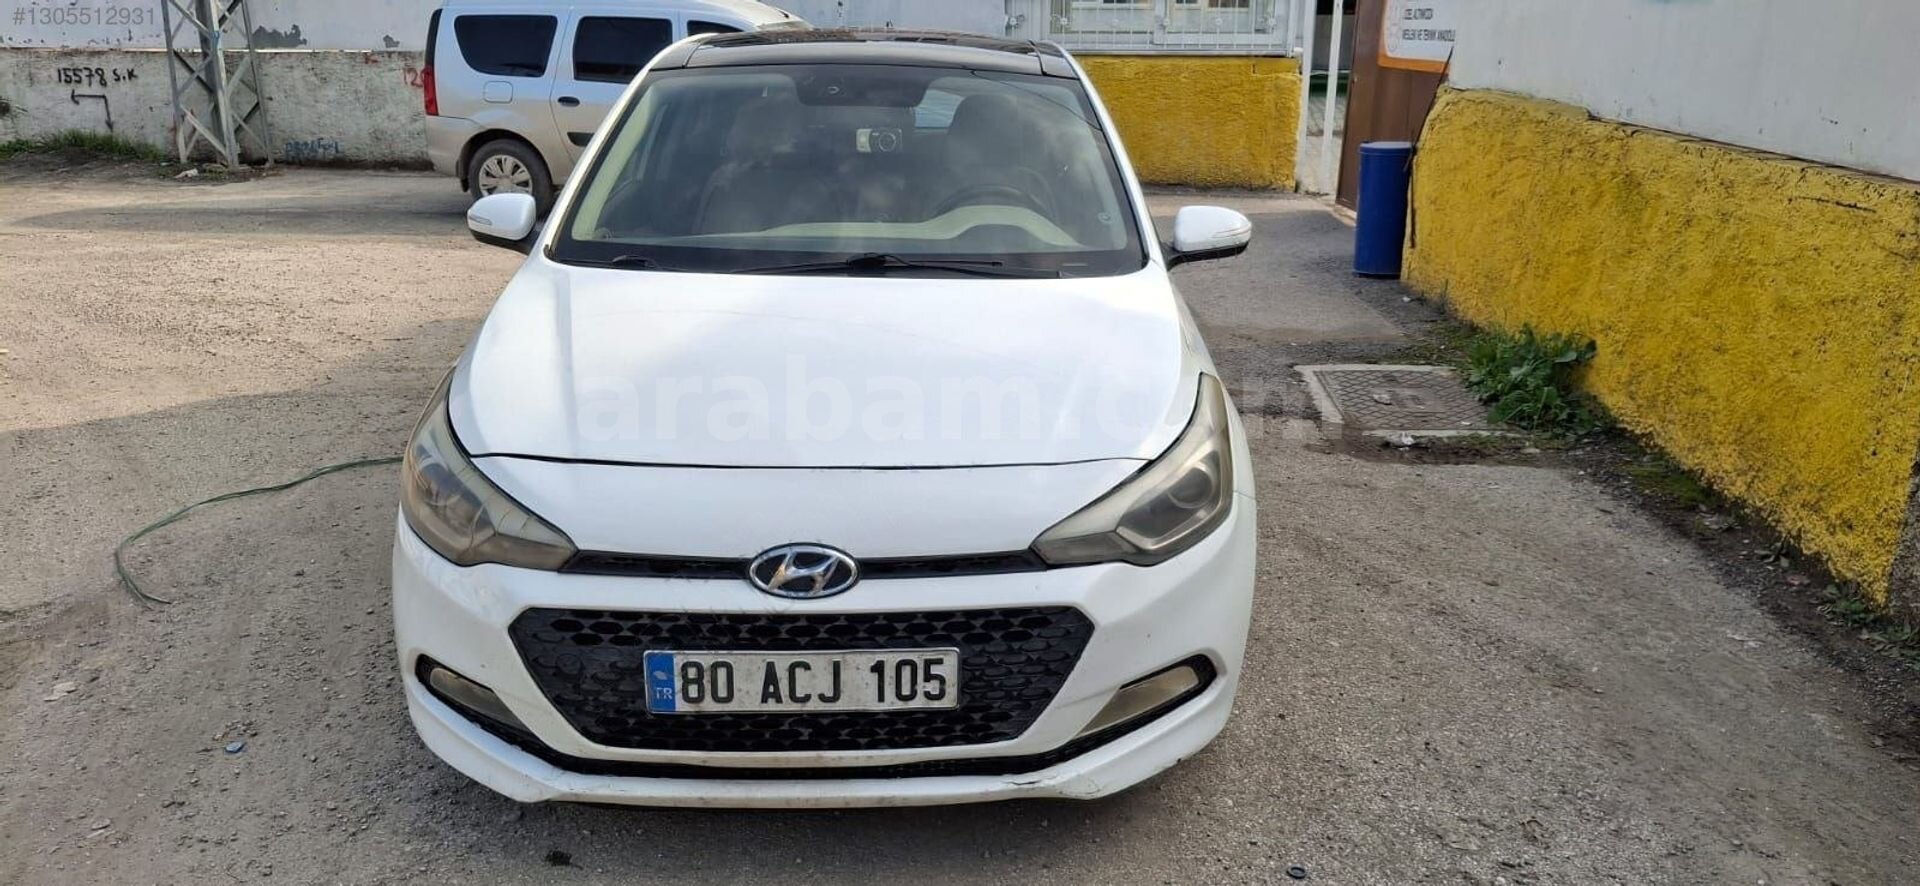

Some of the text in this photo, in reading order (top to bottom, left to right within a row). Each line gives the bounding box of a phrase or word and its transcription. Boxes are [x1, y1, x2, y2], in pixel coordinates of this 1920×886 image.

[57, 66, 107, 88] 15578
[680, 657, 947, 704] 80 ACJ 105
[656, 687, 673, 700] TR
